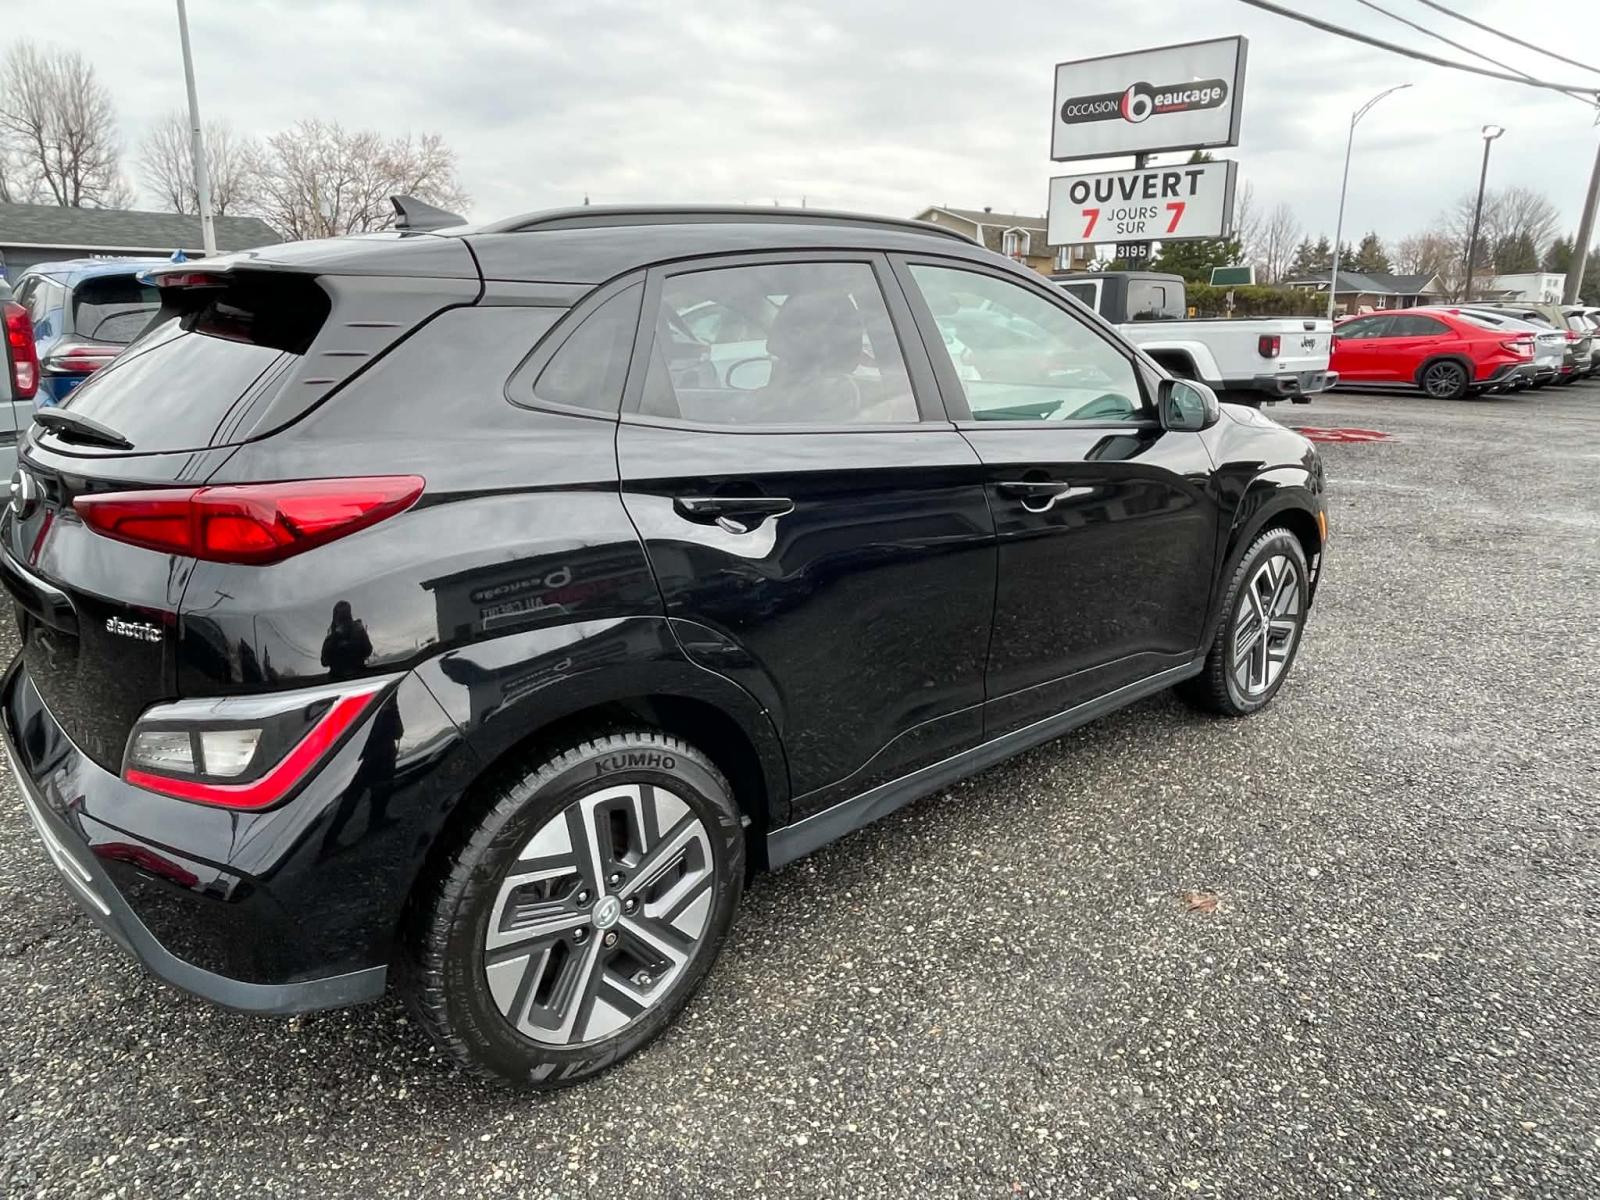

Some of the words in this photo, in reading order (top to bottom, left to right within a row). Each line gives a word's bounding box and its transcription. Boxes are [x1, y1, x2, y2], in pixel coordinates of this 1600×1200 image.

[1067, 101, 1119, 117] OCCASION
[1069, 169, 1205, 204] OUVERT
[1082, 208, 1100, 239] 7
[1107, 206, 1158, 221] JOURS
[1166, 202, 1186, 233] 7
[1116, 221, 1145, 234] SUR
[1117, 245, 1147, 258] 3195
[106, 616, 162, 642] electric
[595, 752, 676, 777] KUMHO
